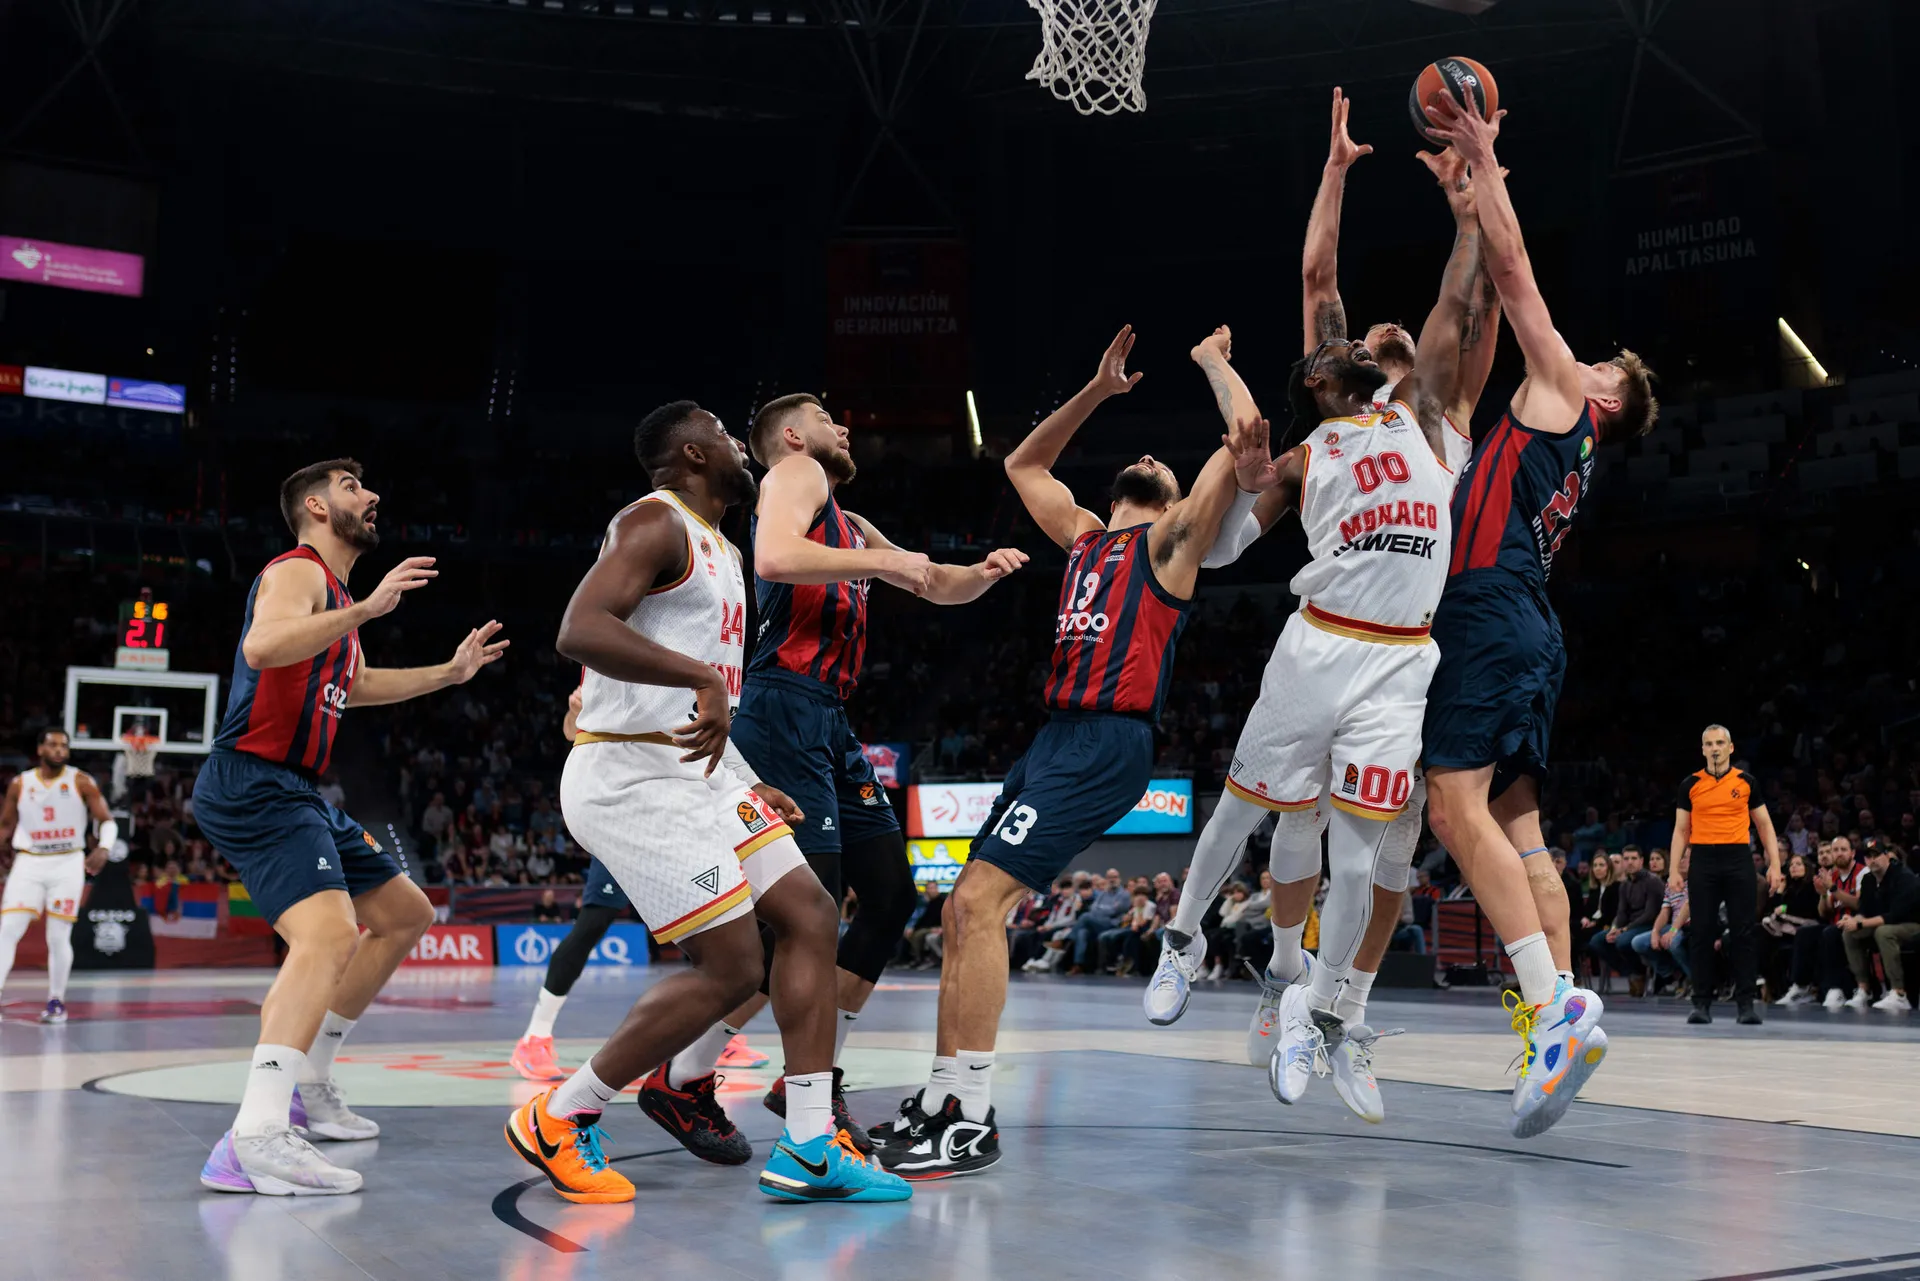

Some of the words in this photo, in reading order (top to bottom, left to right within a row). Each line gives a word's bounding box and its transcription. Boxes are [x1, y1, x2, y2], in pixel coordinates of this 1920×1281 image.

[1637, 216, 1741, 250] HUMILDAD
[1625, 238, 1757, 276] APALTASUNA
[843, 289, 950, 314] INNOVACIÓN
[834, 316, 958, 335] BERRIHUNTZA
[1352, 451, 1411, 494] 00
[1338, 499, 1437, 543] MONACO
[1067, 571, 1100, 611] 13
[719, 598, 743, 646] 24
[323, 683, 347, 710] CAZ
[967, 791, 997, 806] rad
[1358, 764, 1408, 809] 00
[991, 800, 1038, 846] 13
